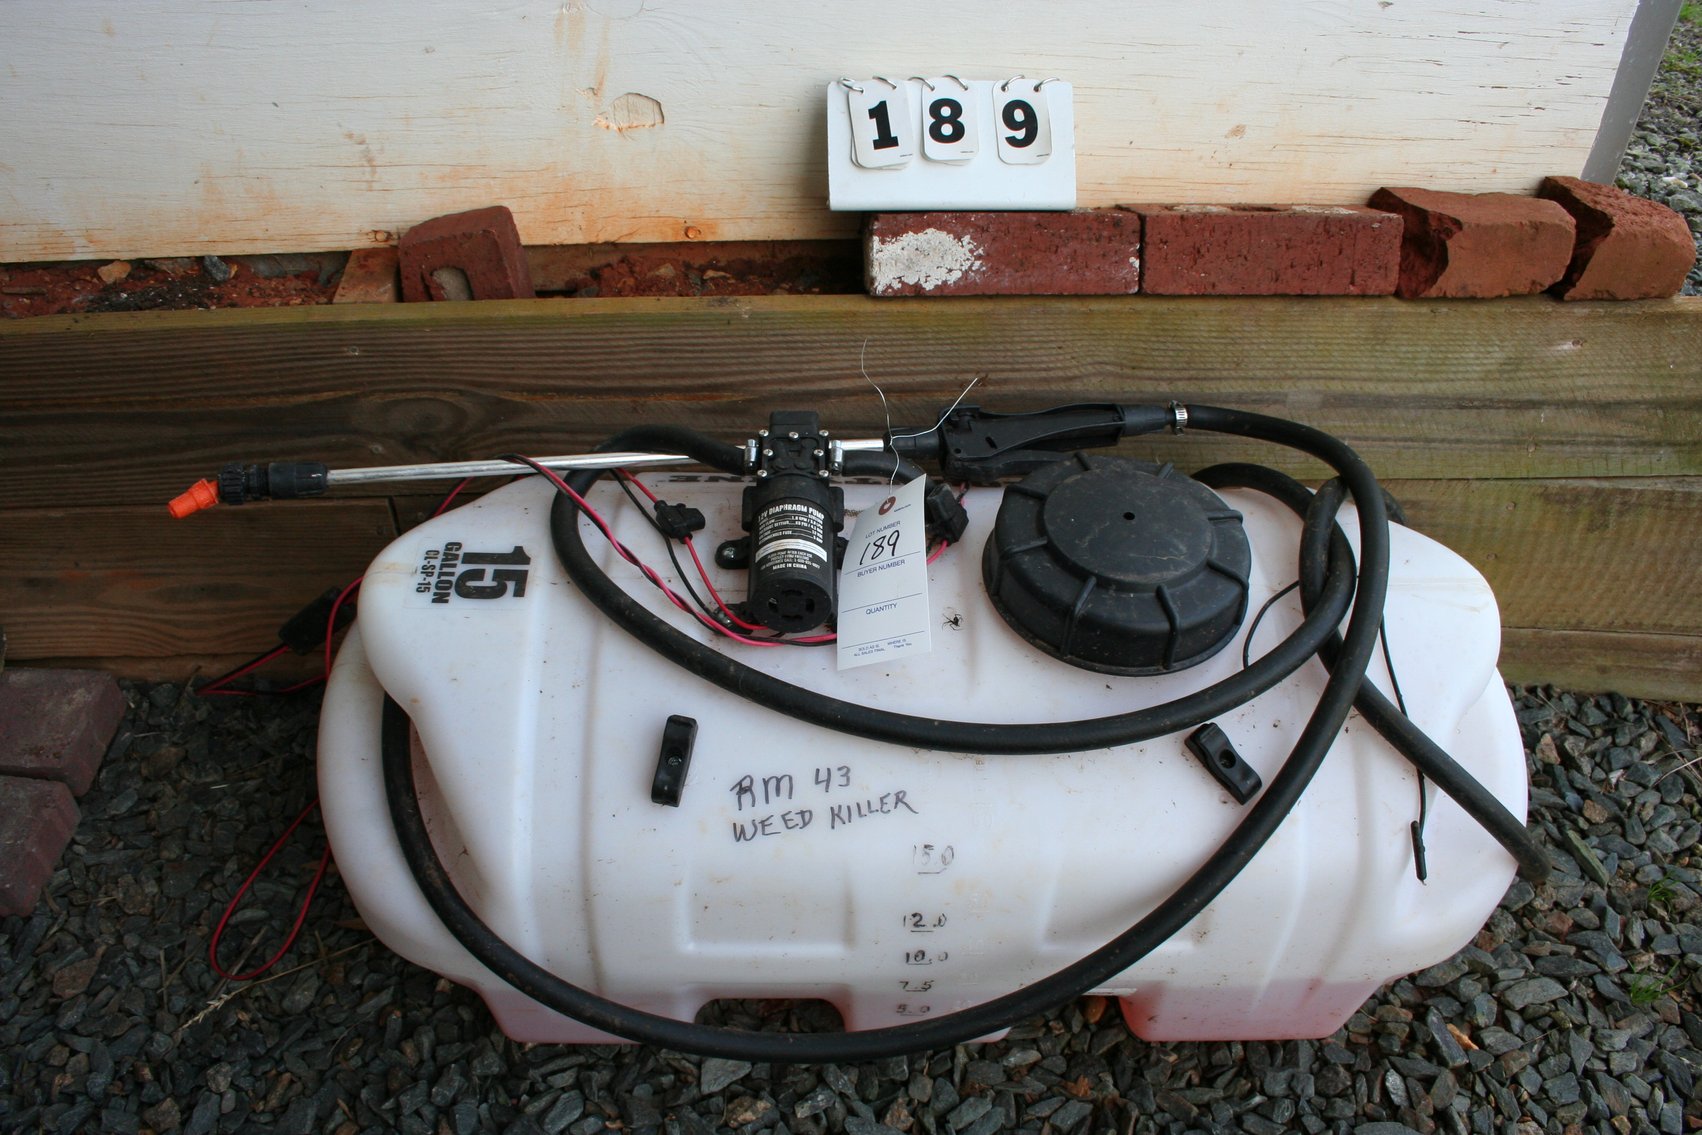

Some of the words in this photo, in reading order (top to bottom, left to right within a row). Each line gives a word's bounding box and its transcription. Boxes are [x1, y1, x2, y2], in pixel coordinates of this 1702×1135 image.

[769, 504, 808, 515] DIAPHRAGM
[808, 507, 825, 520] PUMP
[865, 530, 876, 539] LOT
[876, 520, 901, 534] NUMBER
[859, 529, 901, 566] 189
[416, 549, 440, 593] CL-SP-15
[431, 541, 462, 604] GALLON
[454, 545, 531, 600] 15
[857, 566, 878, 578] BUYER
[878, 559, 906, 571] NUMBER
[865, 602, 898, 616] QUANTITY
[814, 765, 851, 793] 43
[733, 809, 813, 842] WEED
[830, 790, 919, 830] KILLER
